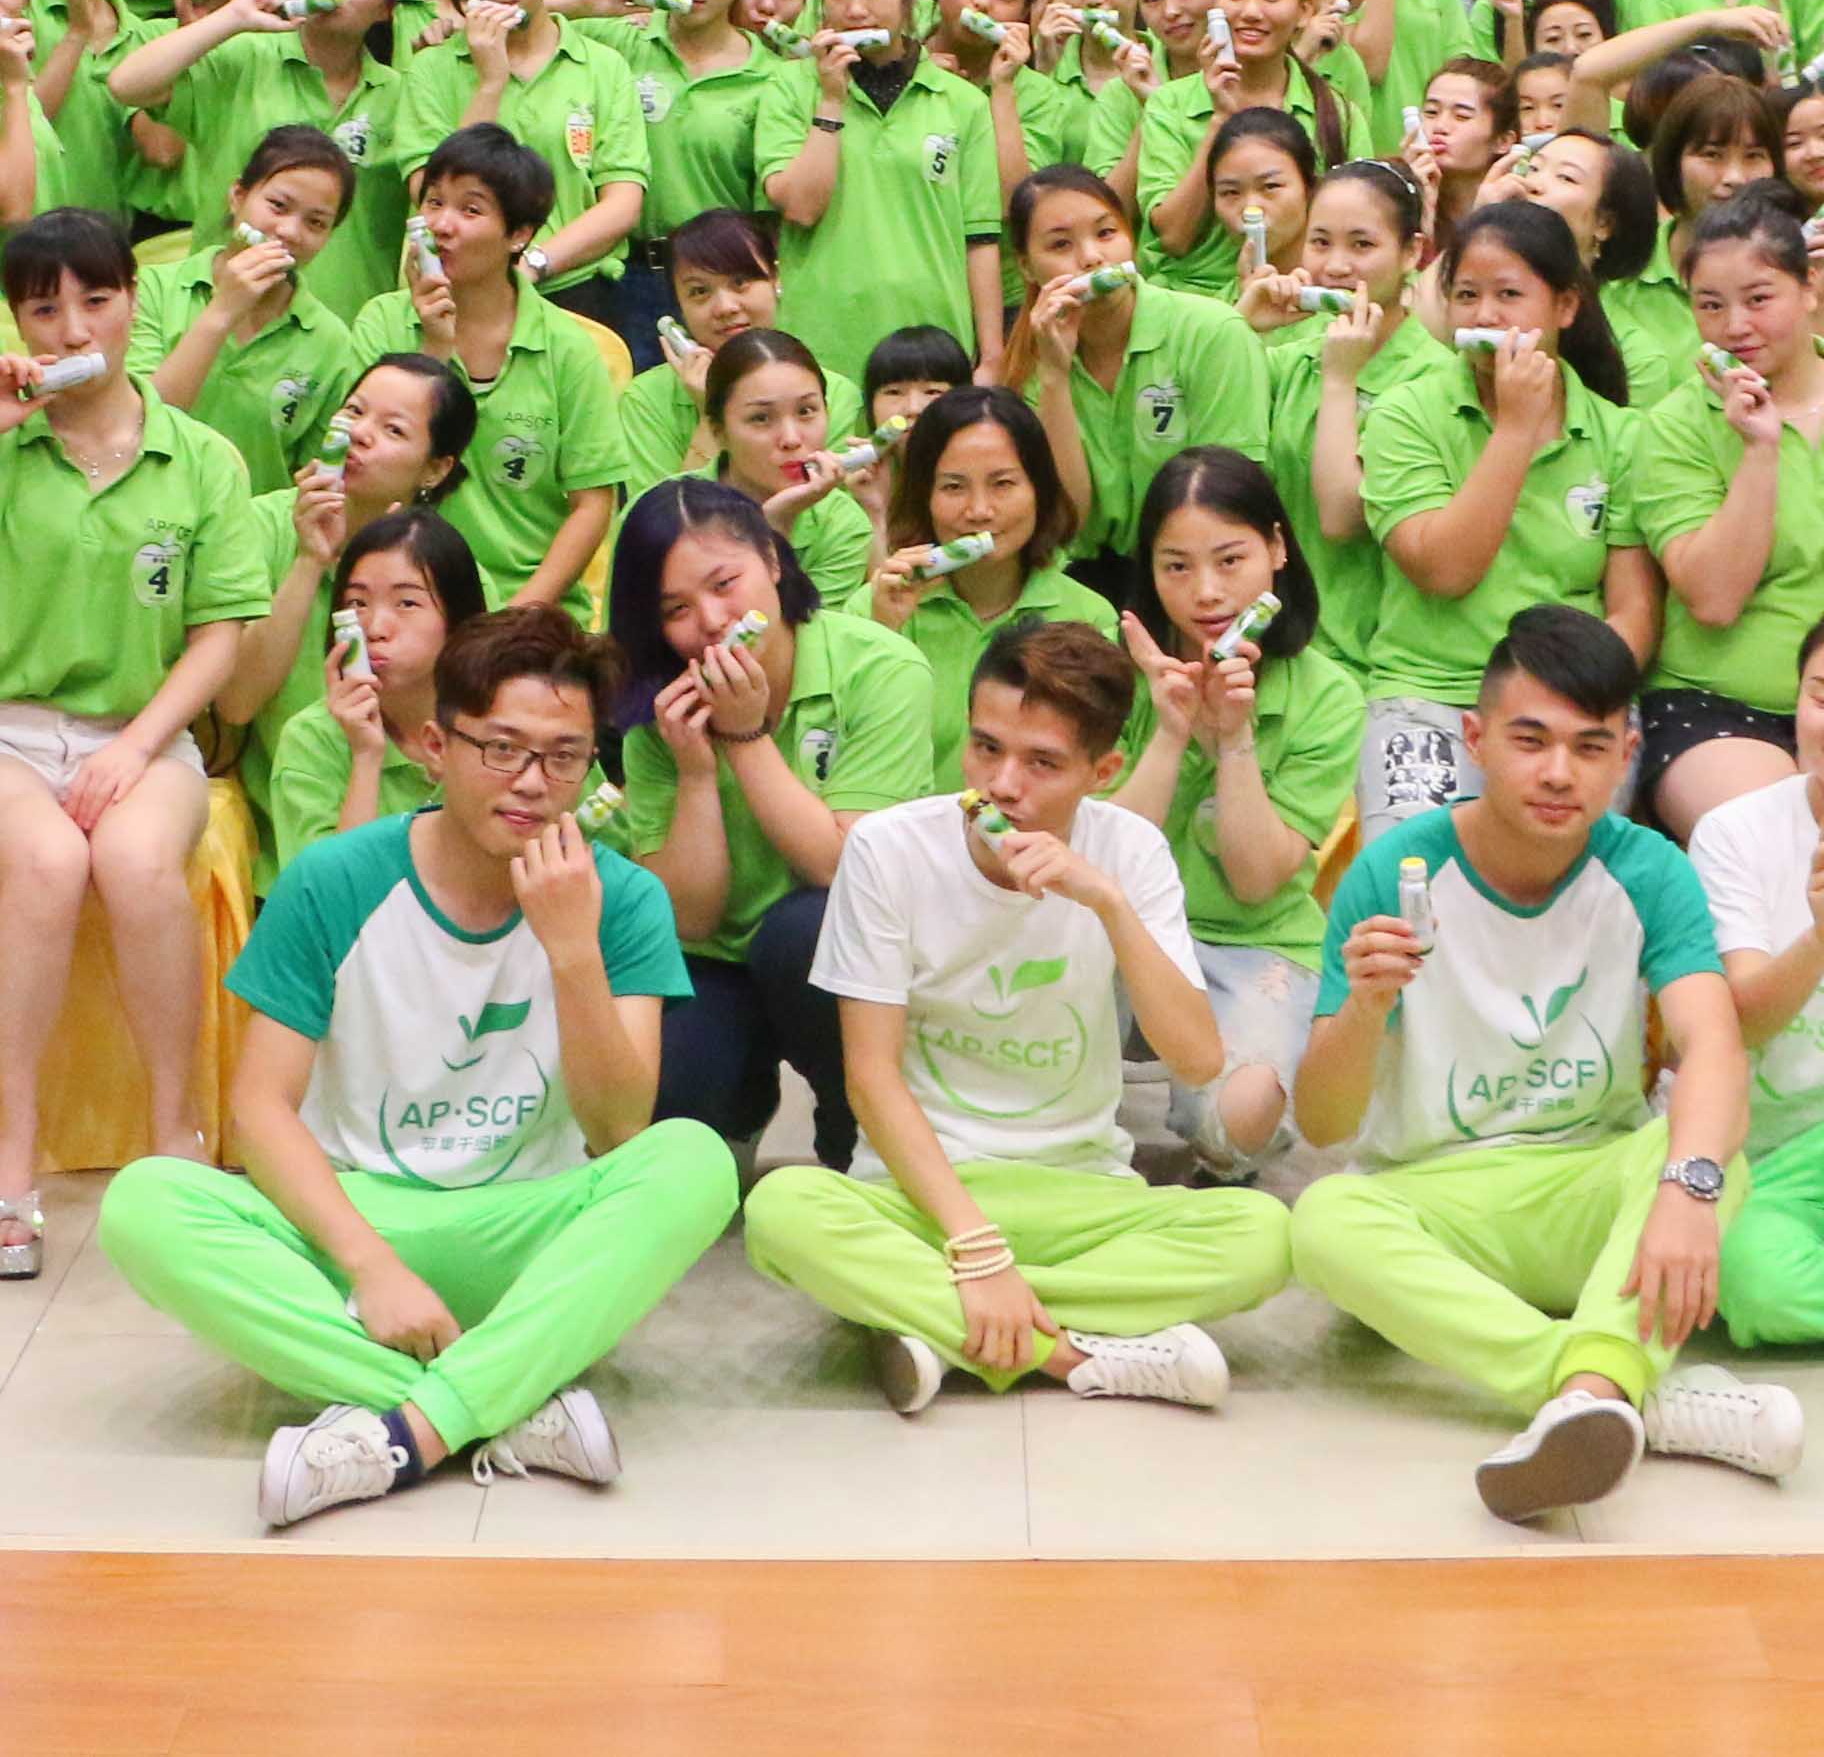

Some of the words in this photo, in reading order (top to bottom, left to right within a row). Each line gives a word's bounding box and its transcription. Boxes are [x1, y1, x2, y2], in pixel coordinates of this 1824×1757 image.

[350, 134, 366, 157] 3
[932, 150, 947, 175] 5
[282, 400, 299, 424] 4
[1152, 405, 1175, 434] 7
[503, 455, 526, 481] 4
[1584, 502, 1604, 531] 7
[148, 565, 169, 595] 4
